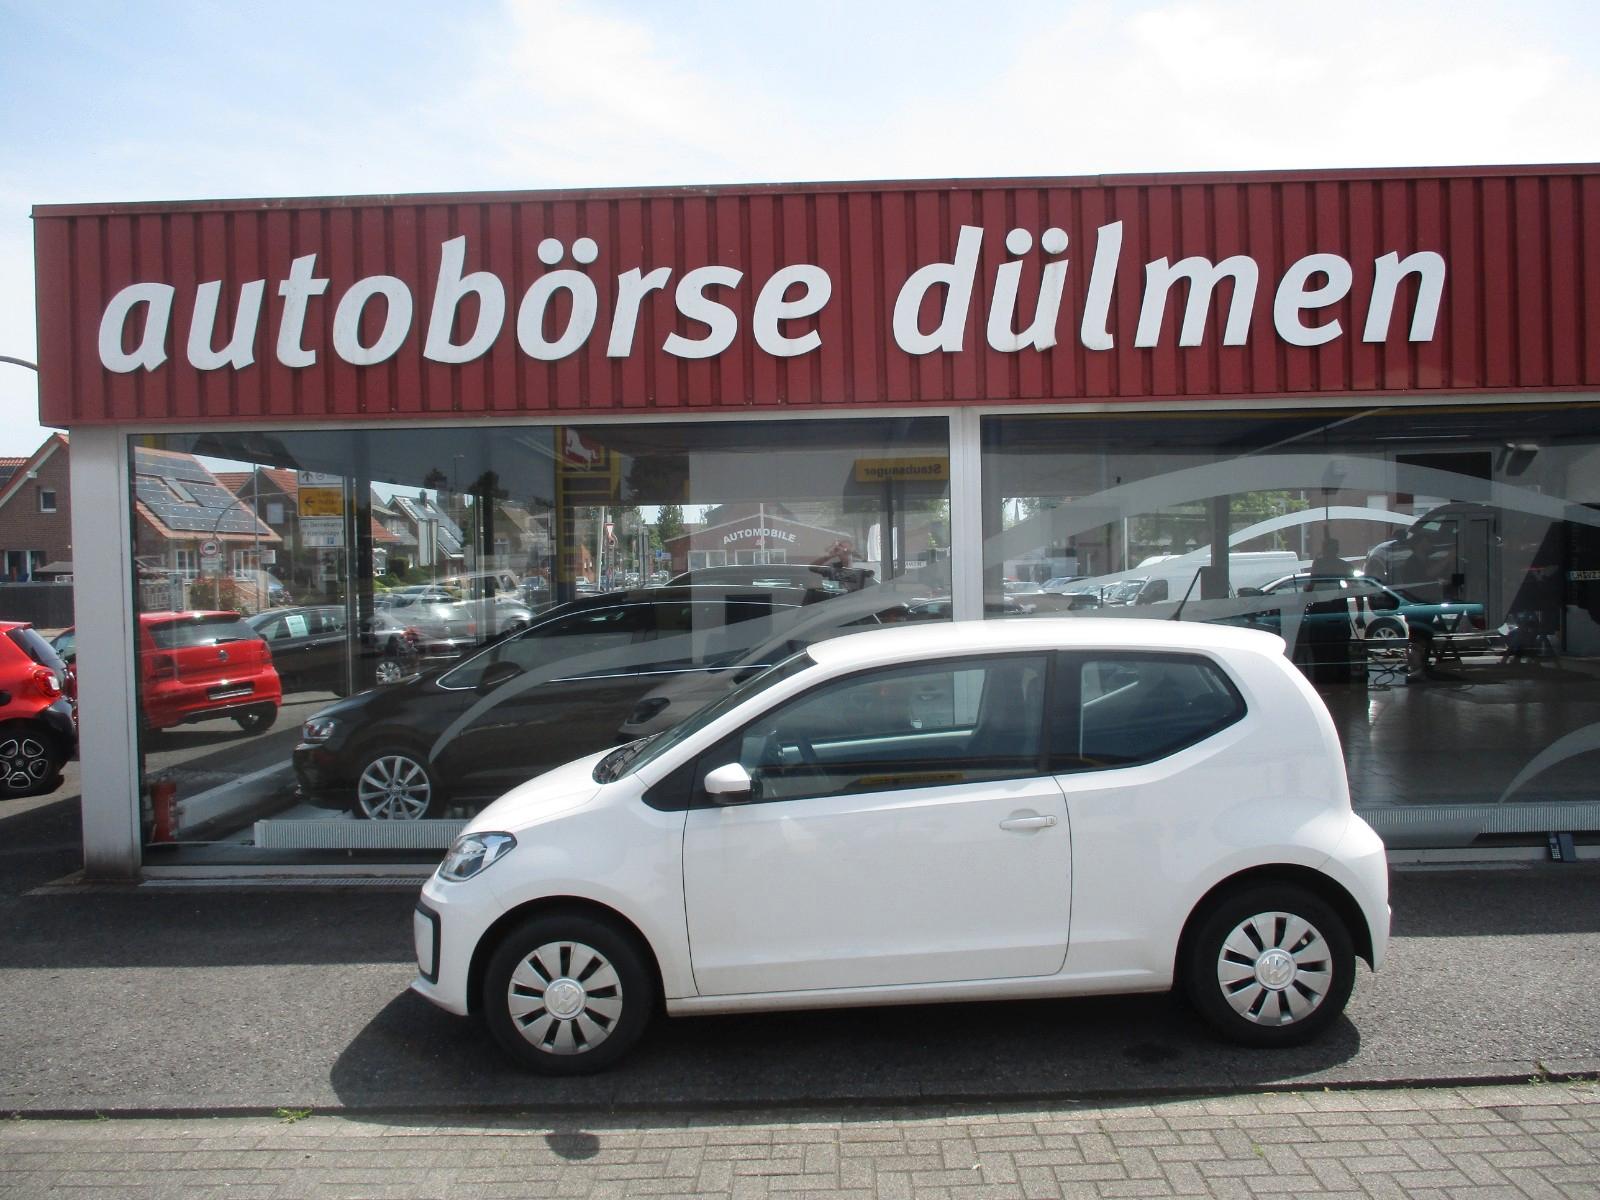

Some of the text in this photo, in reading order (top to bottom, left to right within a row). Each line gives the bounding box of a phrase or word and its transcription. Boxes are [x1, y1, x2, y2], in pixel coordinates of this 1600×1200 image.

[98, 220, 1446, 373] autobörse dülmen
[723, 528, 797, 545] AUTOMOBILE
